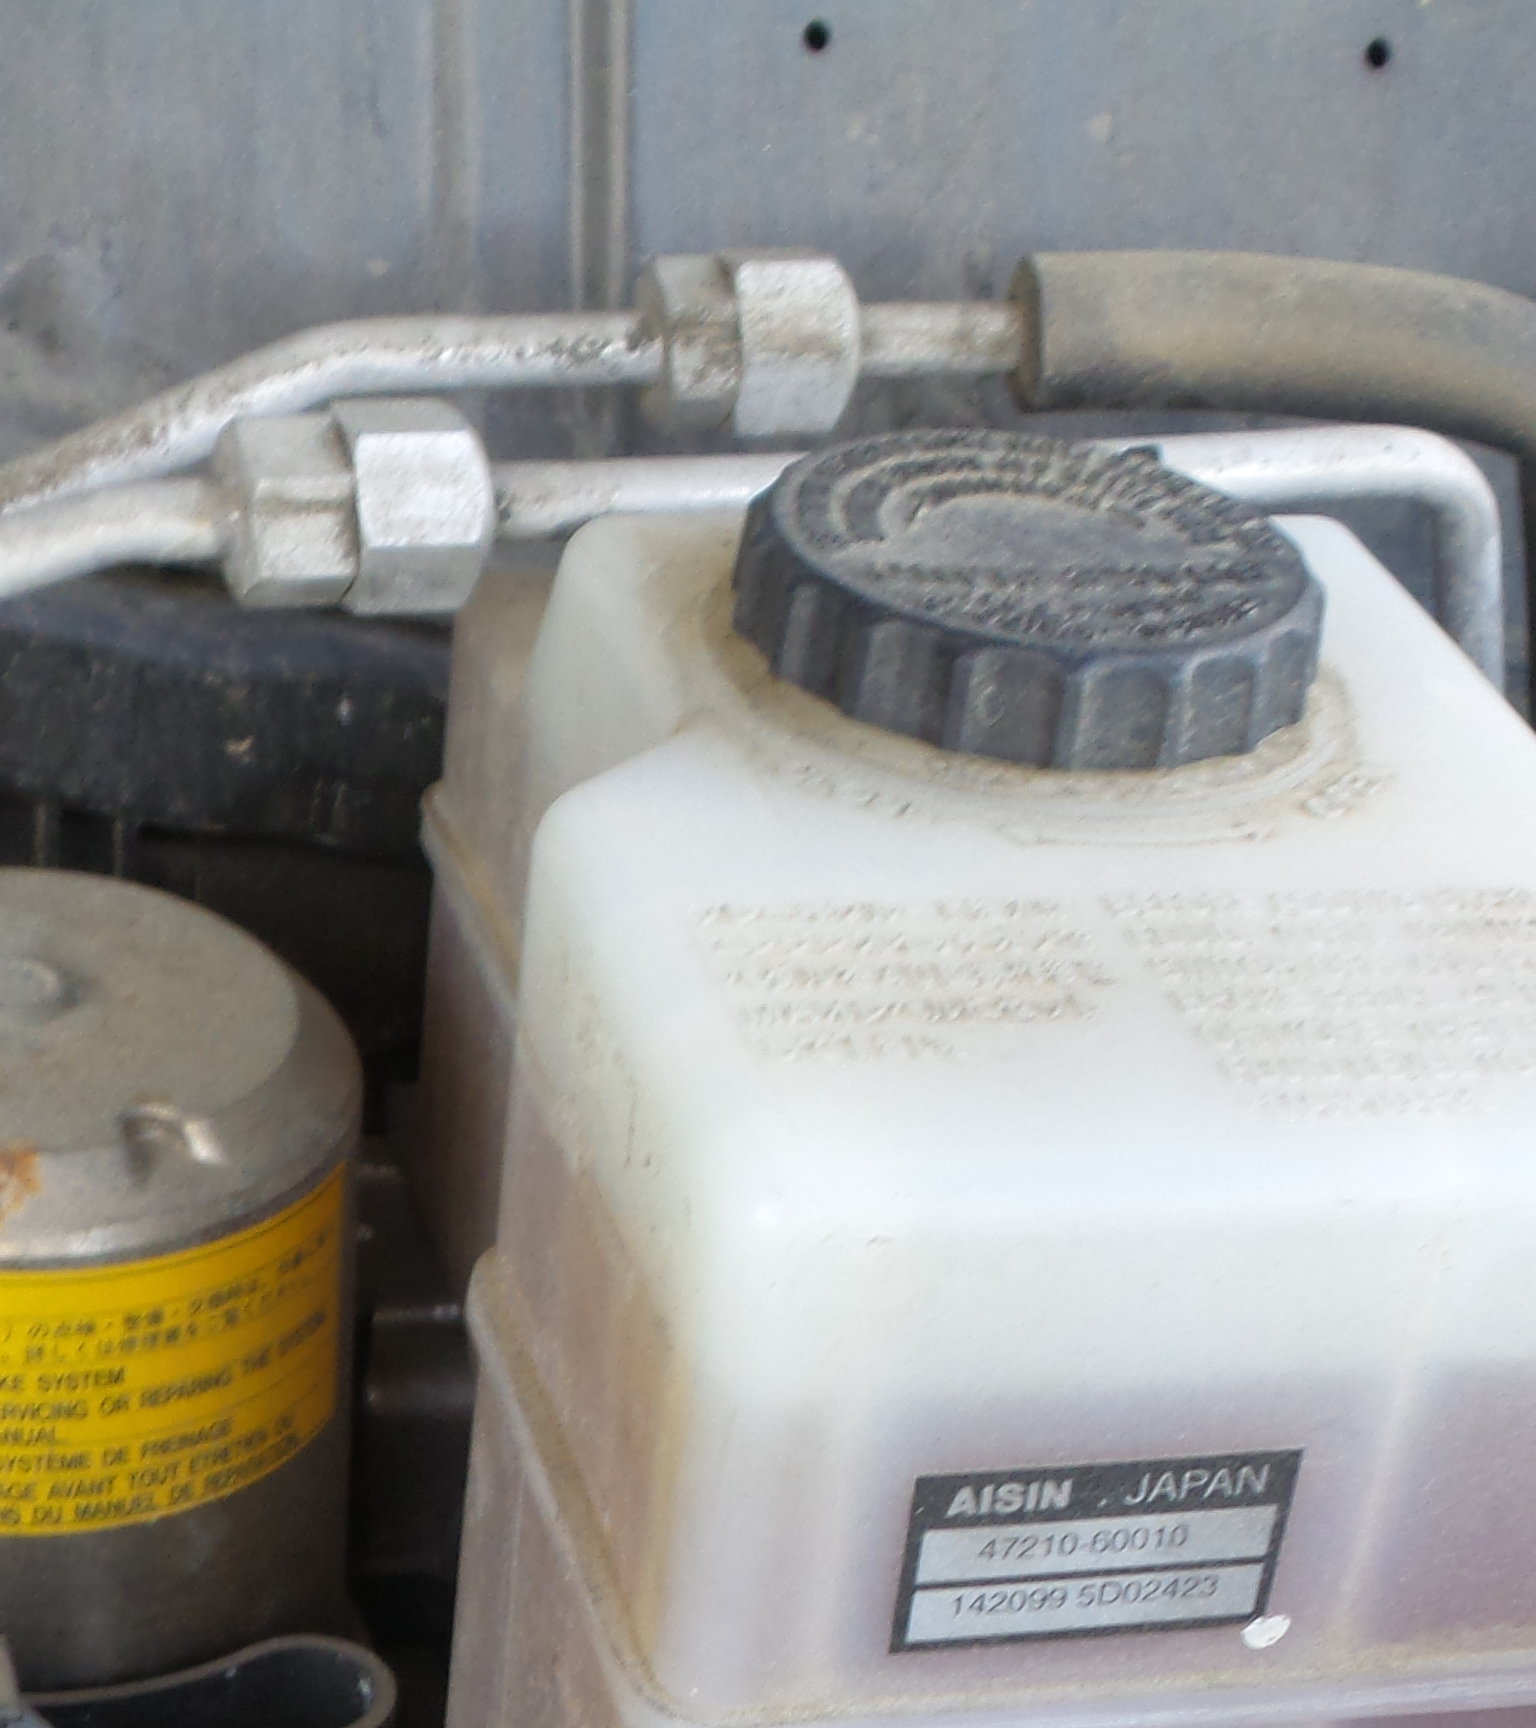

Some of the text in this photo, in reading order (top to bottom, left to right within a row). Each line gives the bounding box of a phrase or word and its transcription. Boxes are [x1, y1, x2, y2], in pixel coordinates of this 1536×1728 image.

[36, 1367, 126, 1391] SYSTEM
[99, 1395, 130, 1415] OR
[99, 1445, 131, 1466] DE
[45, 1476, 119, 1500] AVANT
[130, 1459, 183, 1487] TOUT
[944, 1463, 1272, 1518] AISIN JAPAN
[29, 1503, 66, 1525] DU
[73, 1494, 158, 1519] MANUEL
[978, 1523, 1189, 1560] 47210-60010
[952, 1589, 1068, 1619] 142099
